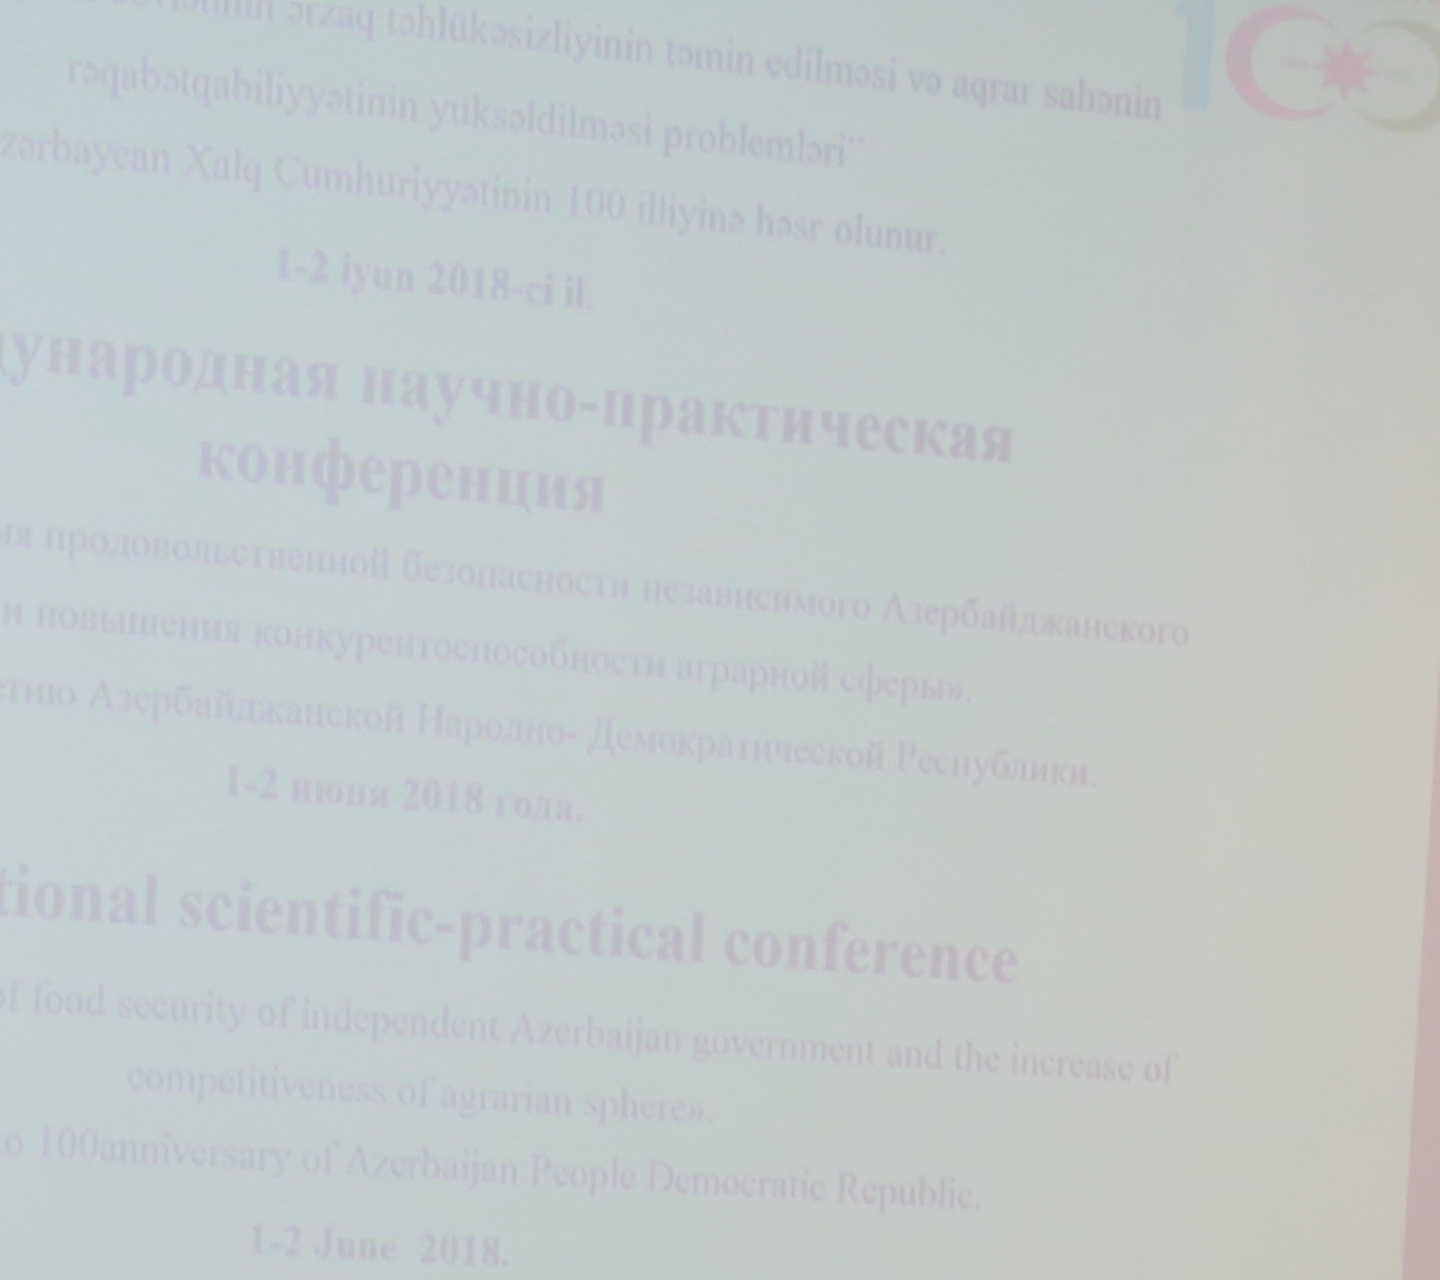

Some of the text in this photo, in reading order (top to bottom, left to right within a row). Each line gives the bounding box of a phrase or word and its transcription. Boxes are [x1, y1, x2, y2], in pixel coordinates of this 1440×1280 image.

[286, 0, 376, 43] ərzaq
[665, 37, 756, 77] təmin
[763, 44, 898, 93] edilməsi
[906, 68, 944, 97] və
[951, 74, 1035, 111] aqrar
[1042, 75, 1163, 122] sahənin
[428, 91, 654, 149] yüksəldilməsi
[182, 142, 263, 196] Xalq
[568, 183, 628, 222] 100
[636, 189, 747, 239] illiyinə
[754, 200, 824, 244] həsr
[832, 211, 945, 256] olunur.
[276, 245, 593, 311] 1-2 iyun 2018-ci il.
[197, 435, 607, 515] конференция
[400, 548, 632, 602] безопасности
[641, 578, 873, 621] независимого
[1, 601, 25, 627] и
[35, 604, 242, 646] повышения
[675, 657, 831, 697] аграрной
[416, 701, 579, 749] Народно-
[895, 739, 1097, 789] Республики.
[226, 763, 584, 824] 1-2 июня 2018 года.
[722, 918, 1020, 987] conference
[32, 978, 106, 1019] food
[116, 989, 248, 1035] security
[255, 993, 297, 1031] of
[300, 995, 500, 1044] independent
[509, 1011, 683, 1060] Azerbaijan
[690, 1031, 876, 1067] government
[885, 1036, 944, 1072] and
[953, 1038, 1002, 1075] the
[1010, 1041, 1136, 1084] increase
[1141, 1051, 1181, 1086] of
[396, 1074, 437, 1109] of
[438, 1080, 573, 1121] agrarian
[300, 1139, 339, 1176] of
[344, 1145, 520, 1191] Azerbaijan
[530, 1151, 638, 1199] People
[646, 1158, 826, 1203] Democratic
[836, 1169, 981, 1215] Republic.
[251, 1223, 511, 1270] 1-2 June 2018.
